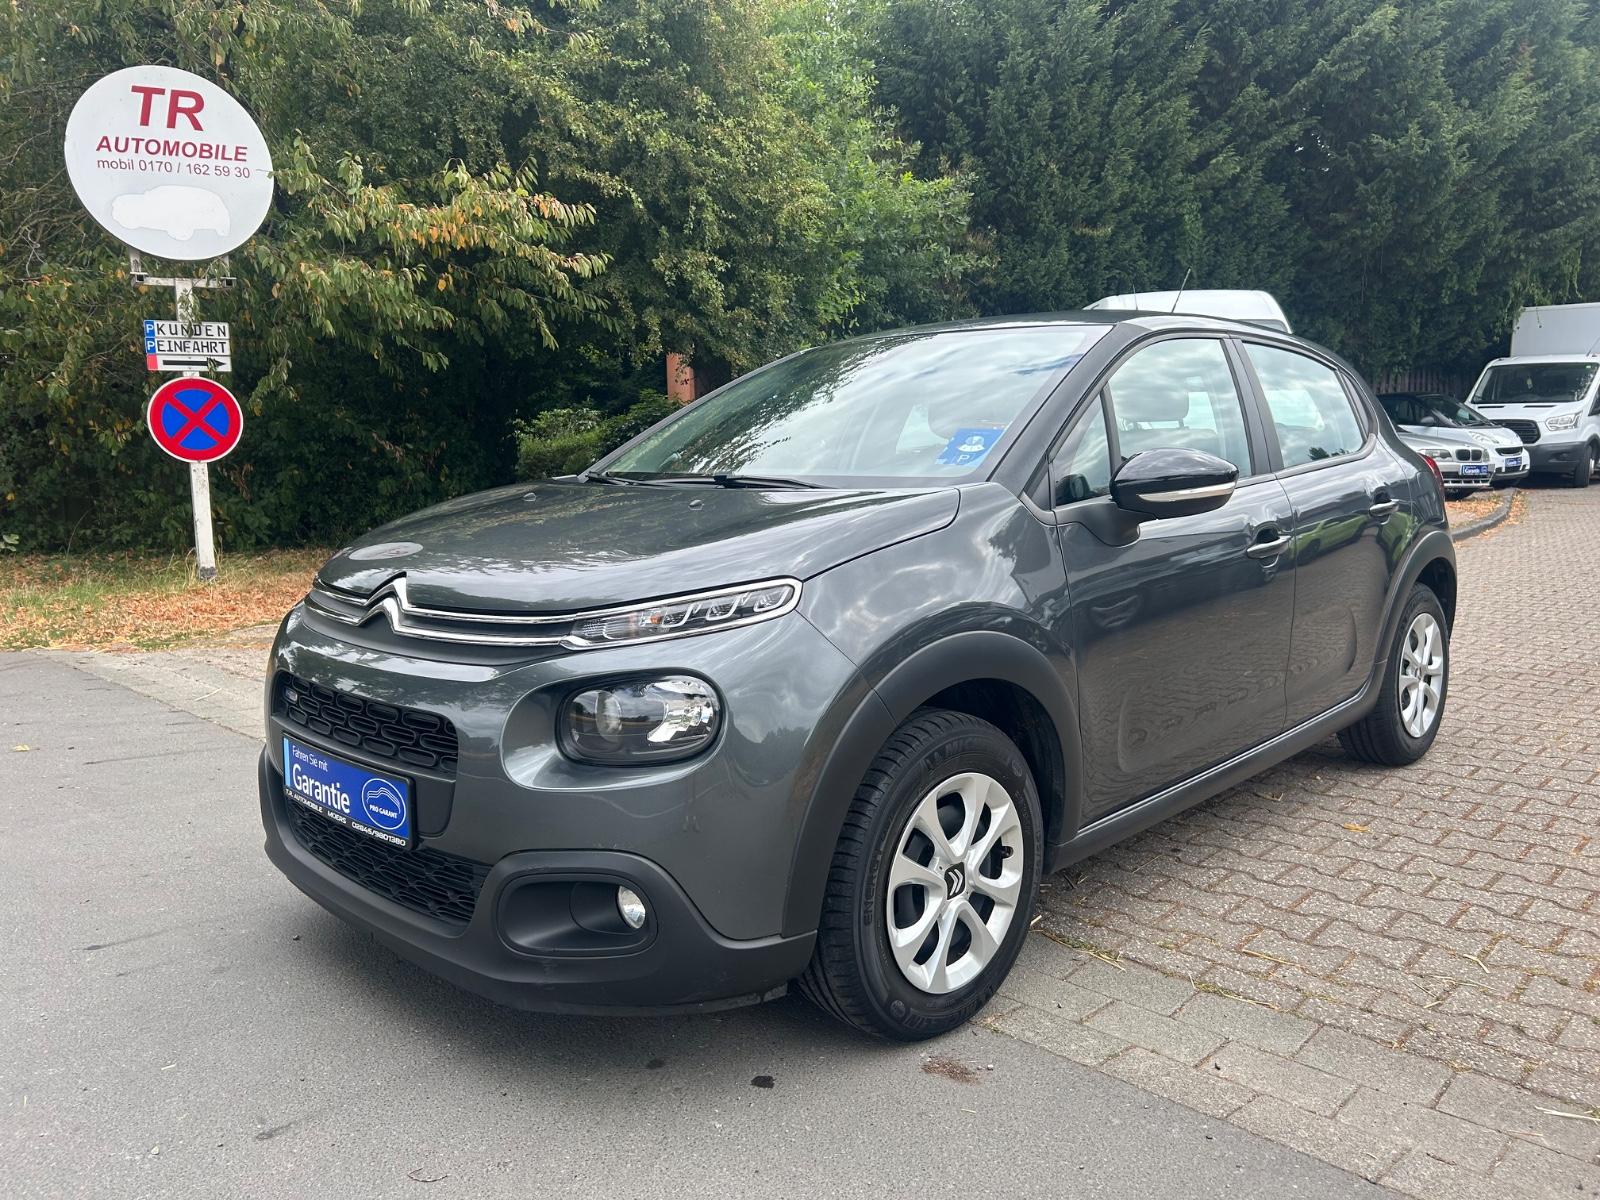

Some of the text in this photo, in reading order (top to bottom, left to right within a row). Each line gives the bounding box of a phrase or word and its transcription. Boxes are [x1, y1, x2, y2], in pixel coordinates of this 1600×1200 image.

[131, 85, 205, 132] TR
[96, 135, 248, 162] AUTOMOBILE
[97, 158, 134, 171] mobil
[138, 159, 173, 173] 0170
[186, 163, 210, 176] 162
[214, 165, 231, 177] 59
[234, 166, 250, 179] 30
[156, 323, 226, 337] KUNDEN
[157, 340, 226, 353] EINFAHRT
[292, 745, 309, 763] Fahren
[309, 753, 318, 768] Sie
[292, 763, 351, 814] Garantie
[293, 793, 323, 813] AUTOMOBILE
